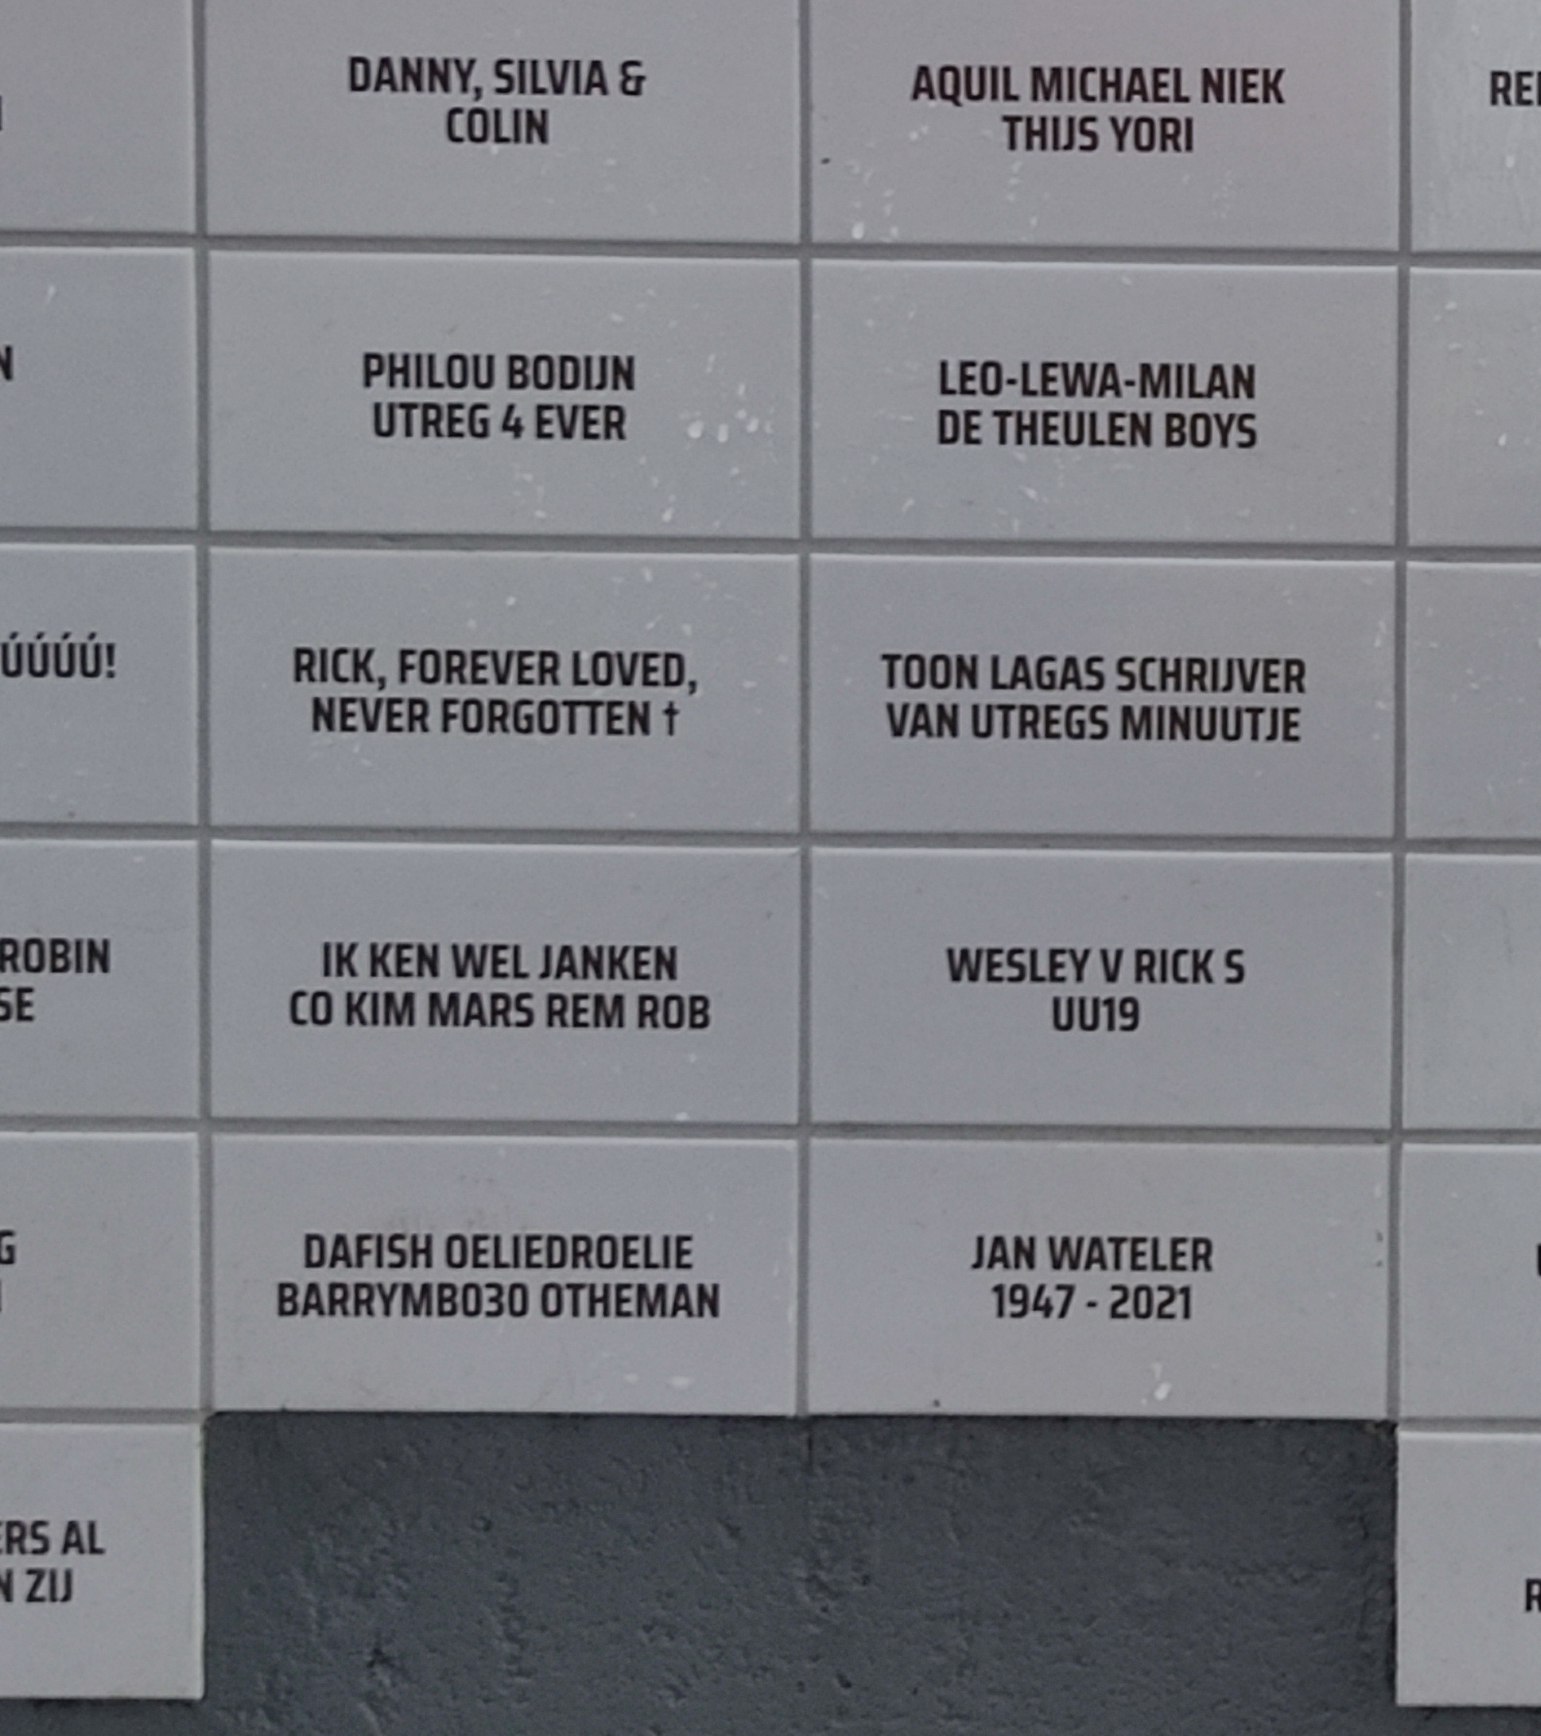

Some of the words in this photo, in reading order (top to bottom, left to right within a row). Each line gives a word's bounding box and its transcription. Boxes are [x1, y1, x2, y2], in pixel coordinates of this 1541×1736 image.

[349, 56, 483, 102] DANNY,
[494, 58, 609, 96] SILVIA
[619, 60, 646, 96] &
[911, 65, 1020, 107] AQUIL
[1031, 66, 1191, 103] MICHAEL
[1201, 68, 1285, 104] NIEK
[446, 107, 548, 144] COLIN
[1001, 115, 1099, 152] THIJS
[1109, 116, 1193, 153] YORI
[363, 352, 495, 390] PHILOU
[507, 354, 634, 391] BODIJN
[940, 360, 1255, 399] LEO-LEWA-MILAN
[373, 402, 490, 439] UTREG
[501, 403, 524, 439] 4
[535, 404, 626, 440] EVER
[938, 409, 982, 445] DE
[992, 410, 1152, 447] THEULEN
[1165, 412, 1257, 449] BOYS
[294, 647, 386, 691] RICK,
[398, 649, 560, 686] FOREVER
[572, 651, 697, 695] LOVED,
[881, 654, 978, 690] TOON
[991, 655, 1105, 692] LAGAS
[1116, 656, 1305, 694] SCHRIJVER
[312, 697, 429, 733] NEVER
[441, 698, 650, 736] FORGOTTEN
[886, 703, 959, 738] VAN
[971, 704, 1109, 740] UTREGS
[1121, 705, 1301, 742] MINUUTJE
[323, 942, 358, 977] IK
[370, 942, 439, 978] KEN
[451, 943, 530, 979] WEL
[539, 945, 677, 981] JANKEN
[1053, 996, 1139, 1032] UU19
[305, 1233, 433, 1269] DAFISH
[445, 1234, 693, 1269] OELIEDROELIE
[971, 1236, 1036, 1270] JAN
[1048, 1236, 1212, 1272] WATELER
[541, 1282, 719, 1318] OTHEMAN
[992, 1283, 1075, 1319] 1947
[1110, 1284, 1191, 1319] 2021
